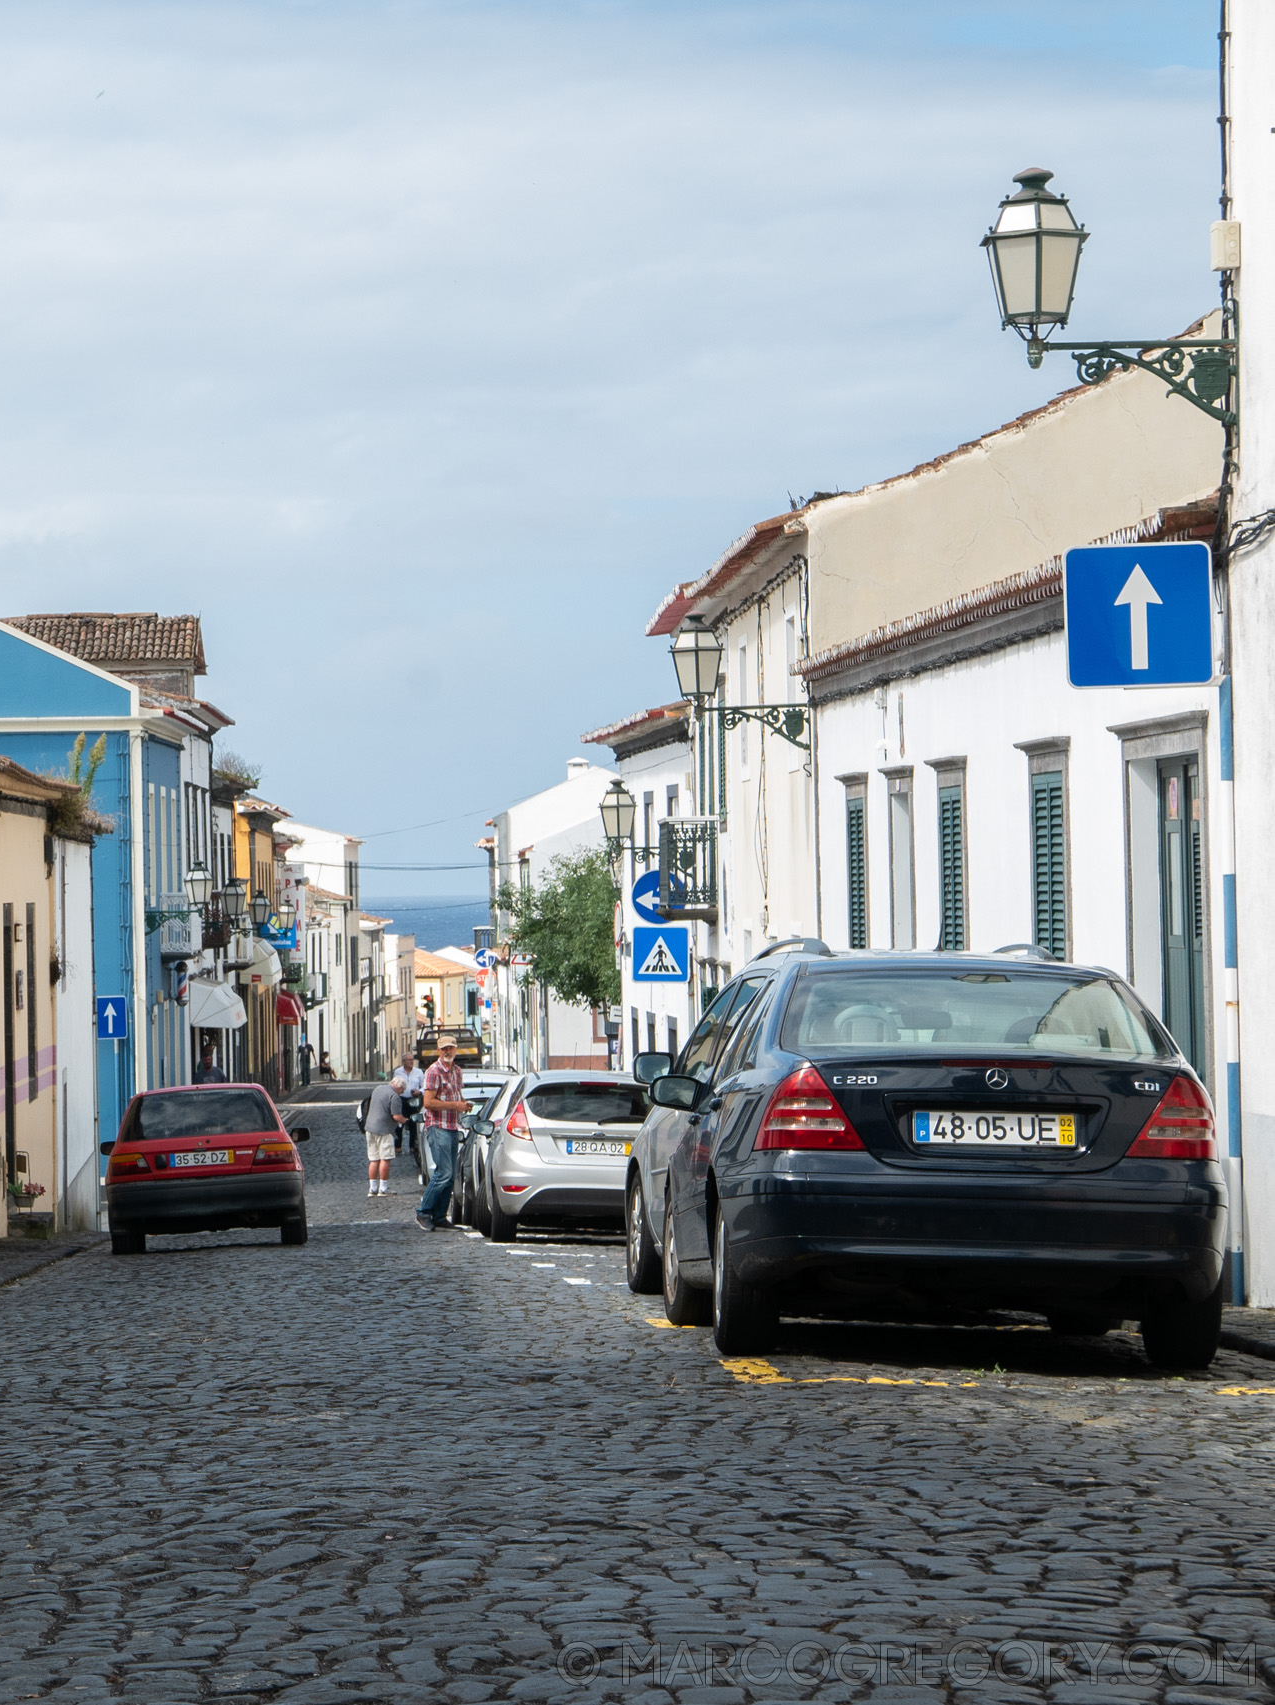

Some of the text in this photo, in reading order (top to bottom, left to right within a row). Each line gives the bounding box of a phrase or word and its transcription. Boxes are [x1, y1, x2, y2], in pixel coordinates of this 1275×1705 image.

[832, 1075, 878, 1085] C 220
[1134, 1081, 1160, 1092] CDI
[1060, 1118, 1073, 1128] 02
[1061, 1133, 1073, 1143] 10
